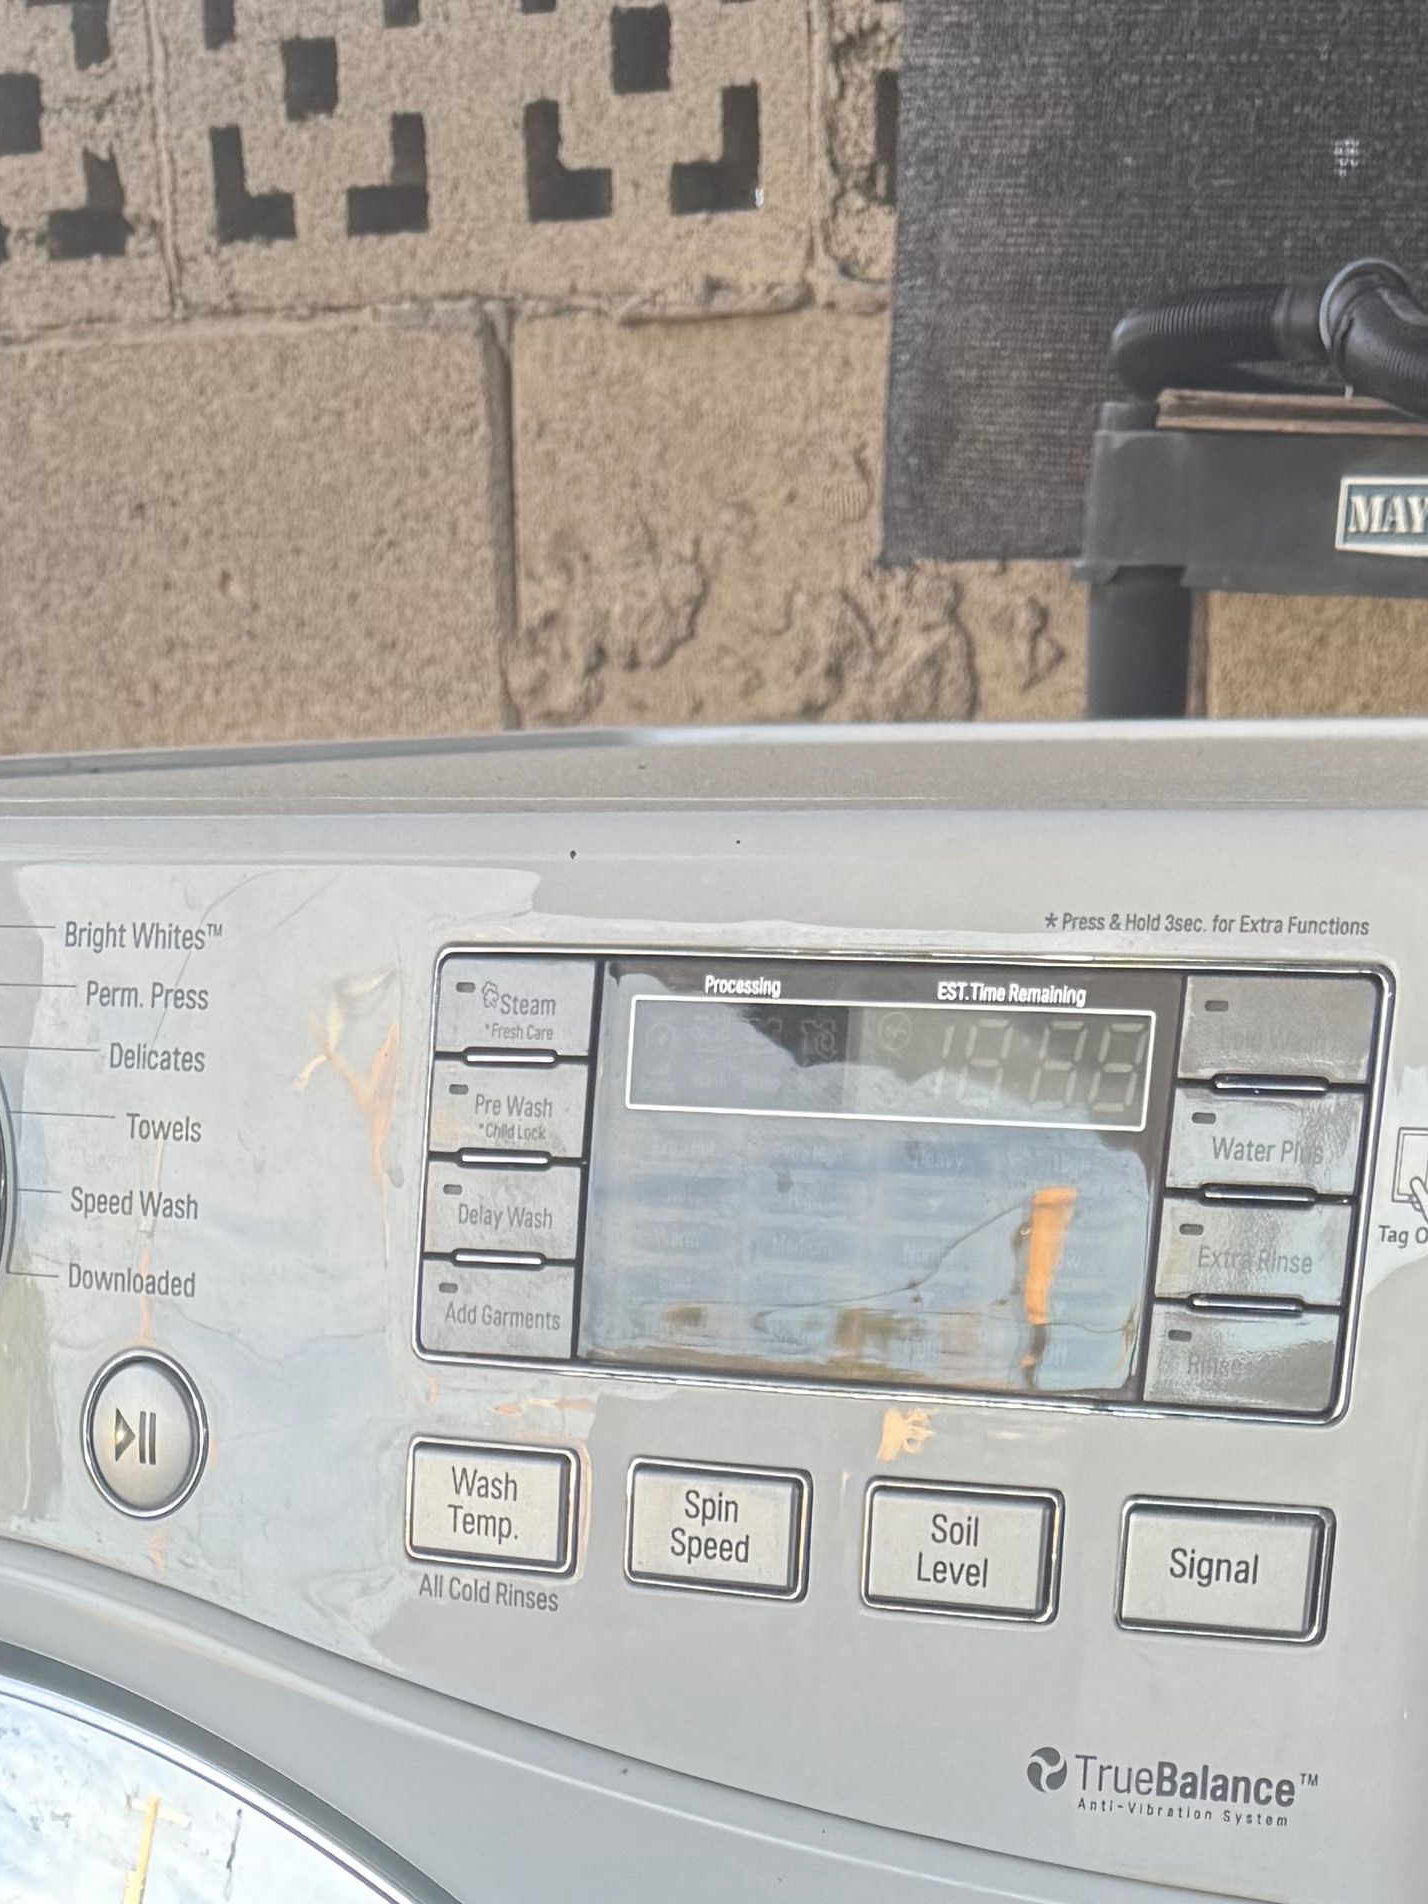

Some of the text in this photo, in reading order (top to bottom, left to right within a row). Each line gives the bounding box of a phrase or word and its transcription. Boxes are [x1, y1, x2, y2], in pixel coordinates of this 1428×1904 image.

[65, 920, 126, 953] Bright
[1062, 913, 1369, 936] Press & Hold 3sec. for Extra Functions
[86, 980, 209, 1010] Perm. Press
[705, 975, 781, 998] Processing
[1008, 984, 1087, 1008] Remaining
[500, 994, 557, 1017] Steam
[526, 1025, 553, 1041] Care
[109, 1042, 205, 1072] Delicates
[475, 1094, 553, 1118] Pre Wash
[126, 1112, 202, 1142] Towels
[517, 1124, 546, 1140] Lock
[1212, 1135, 1324, 1166] Water Plus
[71, 1186, 199, 1220] Speed Wash
[458, 1203, 553, 1230] Delay Wash
[1379, 1225, 1409, 1249] Tag
[1198, 1244, 1313, 1275] Extra Rinse
[68, 1263, 196, 1297] Downloaded
[444, 1302, 561, 1331] Add Garments
[451, 1465, 518, 1501] Wash
[684, 1489, 739, 1527] Spin
[447, 1504, 519, 1544] Temp.
[930, 1513, 979, 1548] Soil
[670, 1528, 750, 1564] Speed
[916, 1552, 988, 1588] Level
[1169, 1547, 1259, 1589] Signal
[419, 1573, 559, 1613] All Cold Rinses
[1077, 1798, 1288, 1827] Anti-Vibration System
